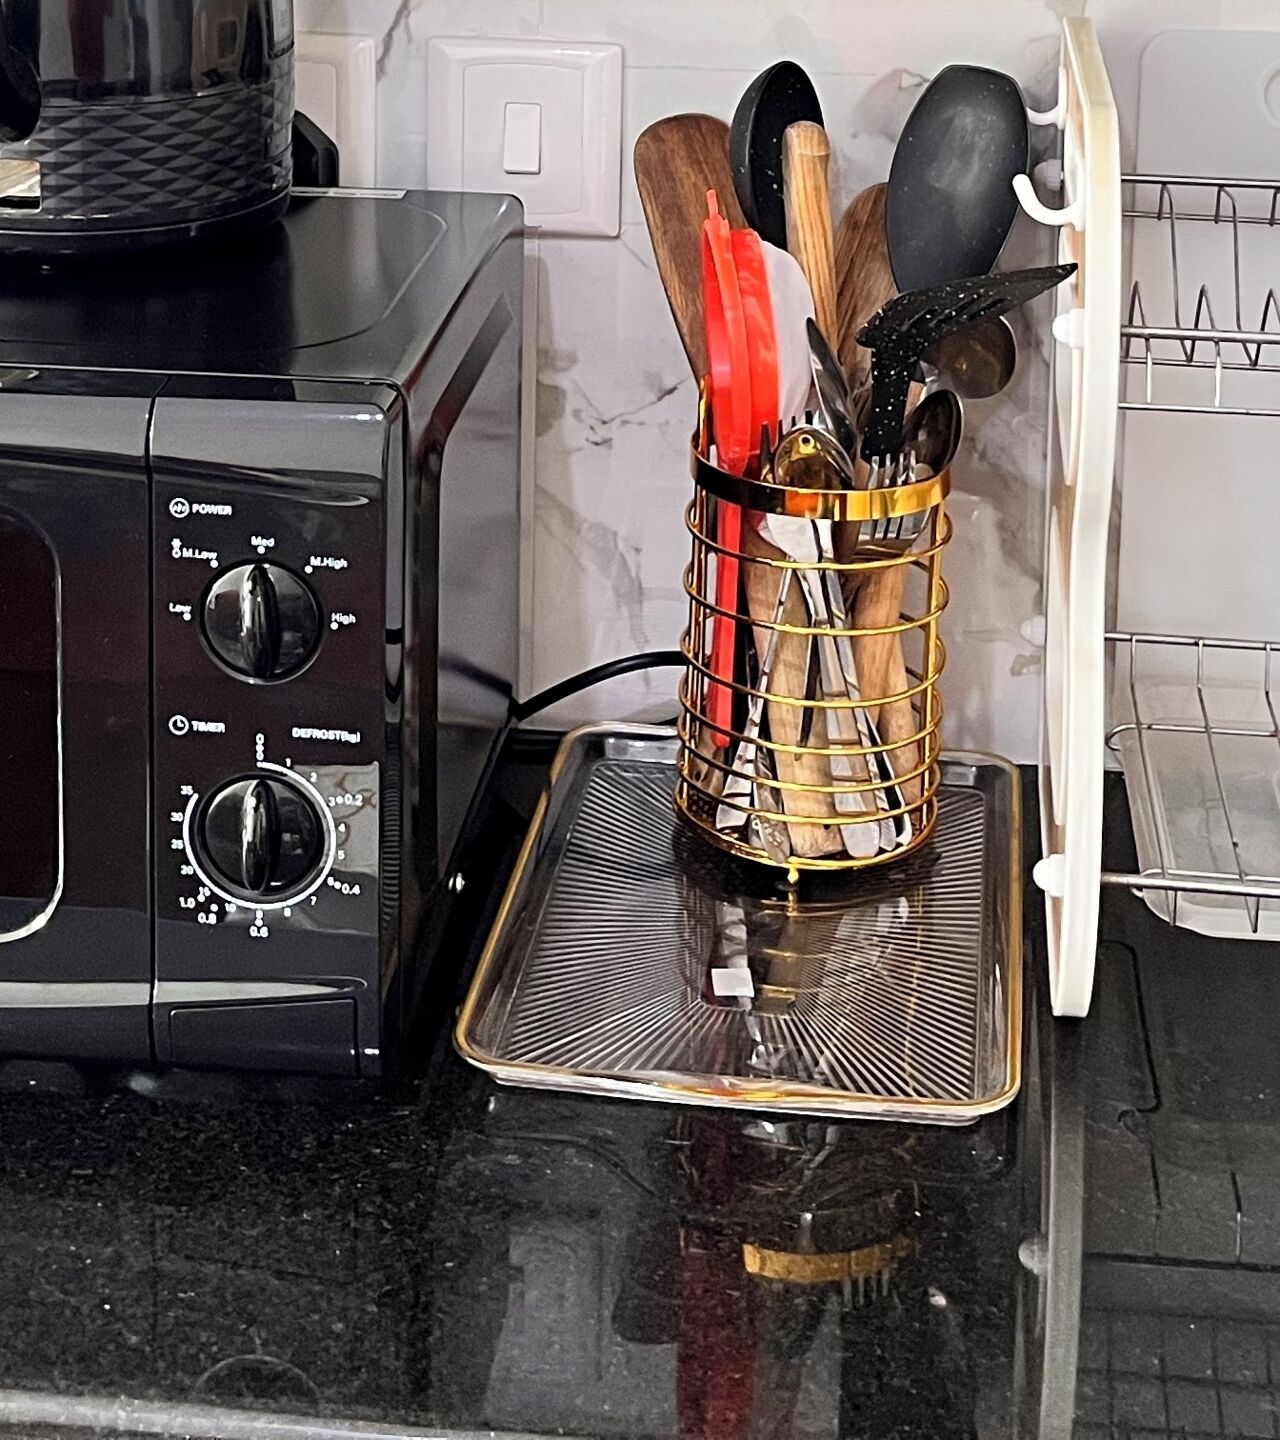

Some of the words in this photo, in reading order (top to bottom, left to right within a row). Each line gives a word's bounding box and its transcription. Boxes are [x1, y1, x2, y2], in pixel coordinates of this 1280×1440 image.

[192, 503, 232, 516] POWER
[251, 536, 275, 547] Med
[169, 602, 192, 613] Low
[331, 613, 356, 625] High
[191, 721, 226, 733] TIMER
[285, 757, 292, 767] 1
[344, 793, 363, 806] 0.2
[341, 882, 361, 895] 0.4
